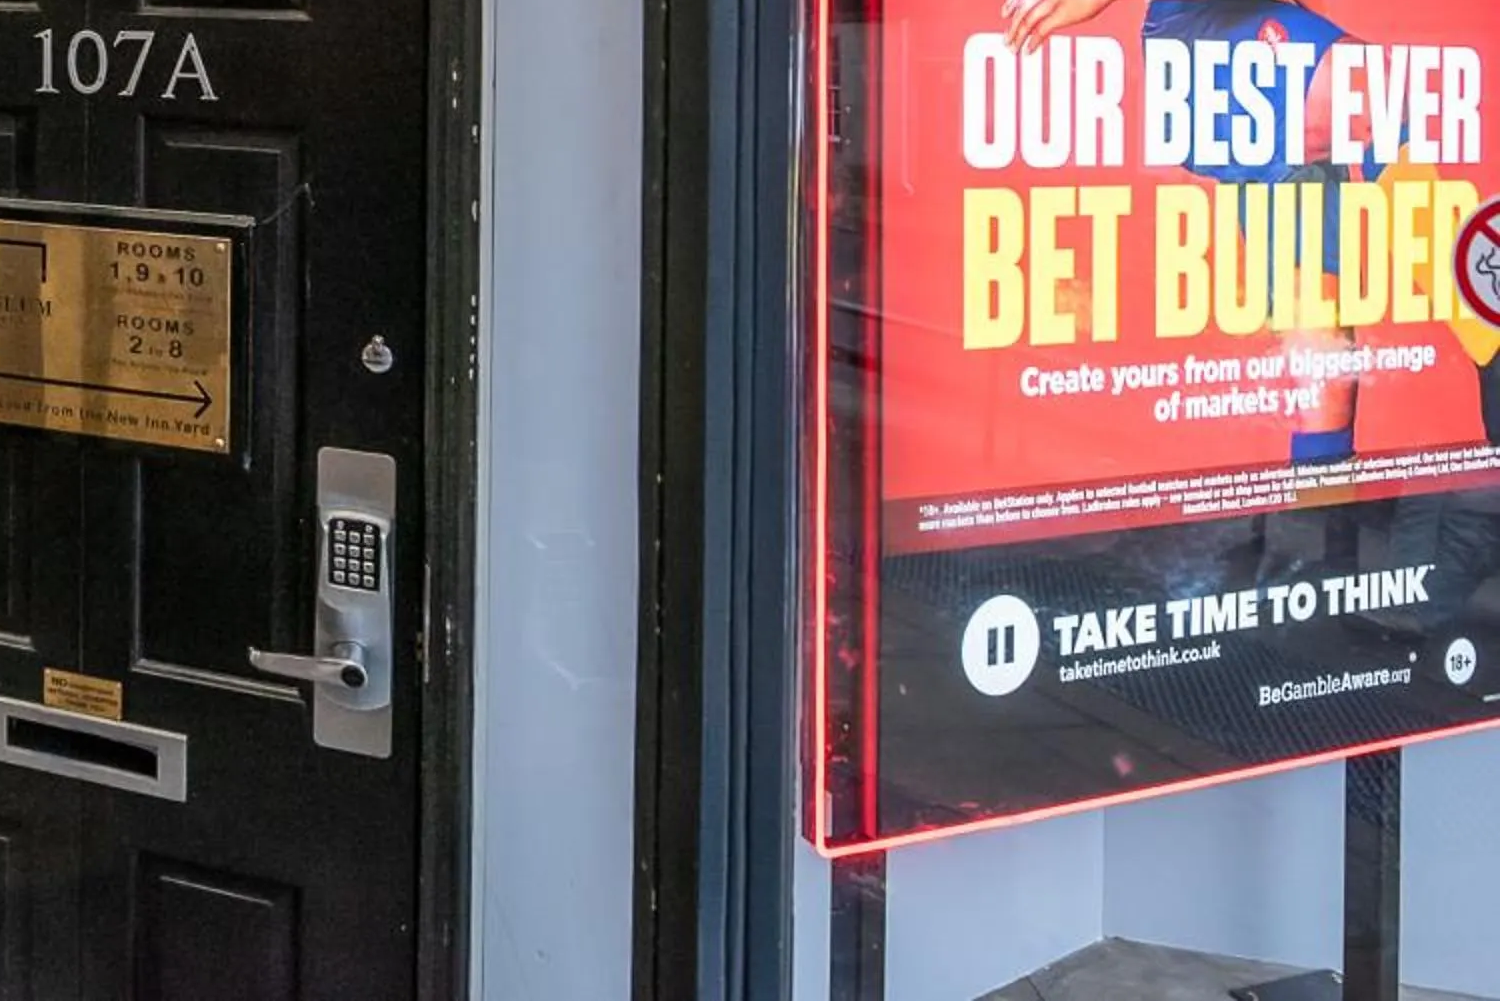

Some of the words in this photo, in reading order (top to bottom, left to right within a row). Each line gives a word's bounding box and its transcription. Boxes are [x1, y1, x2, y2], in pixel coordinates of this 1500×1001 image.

[963, 32, 1126, 169] OUR
[1144, 38, 1316, 167] BEST
[1331, 43, 1483, 165] EVER
[117, 241, 196, 261] ROOMS
[964, 185, 1132, 350] BET
[1155, 180, 1481, 339] BUILDER
[174, 267, 204, 287] 10
[117, 315, 195, 336] ROOMS
[129, 335, 143, 354] 2
[169, 340, 182, 358] 8
[1020, 366, 1105, 397] Create
[1111, 362, 1180, 395] yours
[1184, 354, 1241, 385] from
[1246, 353, 1285, 380] our
[1289, 347, 1372, 379] biggest
[1377, 345, 1436, 372] range
[37, 399, 74, 418] from
[107, 410, 139, 426] New
[174, 420, 210, 437] Yard
[1154, 391, 1181, 422] of
[1185, 384, 1280, 420] markets
[1053, 602, 1157, 656] TAKE
[1166, 588, 1259, 640] TIME
[1267, 580, 1318, 625] TO
[1322, 564, 1430, 616] THINK
[1059, 640, 1221, 684] taketimetothink.co.uk
[1449, 654, 1472, 672] 18+
[1258, 667, 1411, 707] BeGambleAware.org
